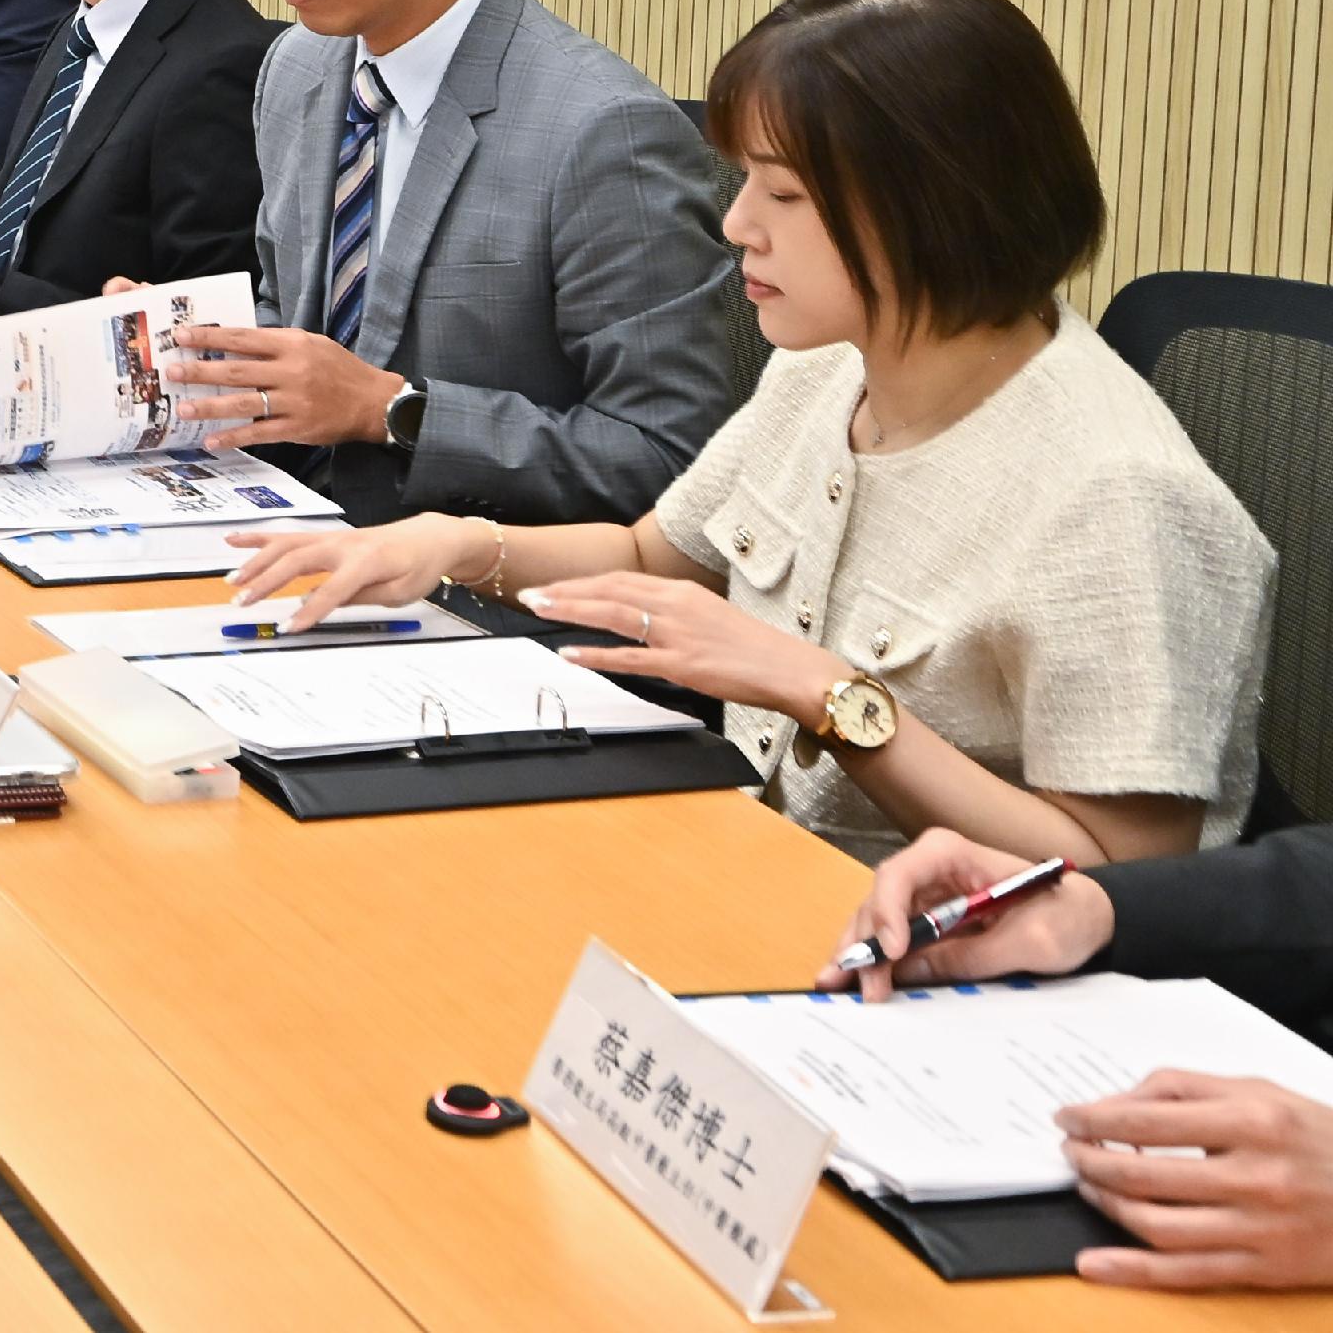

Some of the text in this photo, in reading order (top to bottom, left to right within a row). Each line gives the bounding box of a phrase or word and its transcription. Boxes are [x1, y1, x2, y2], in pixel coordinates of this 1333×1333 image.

[594, 1019, 757, 1190] 蔡嘉傑博士
